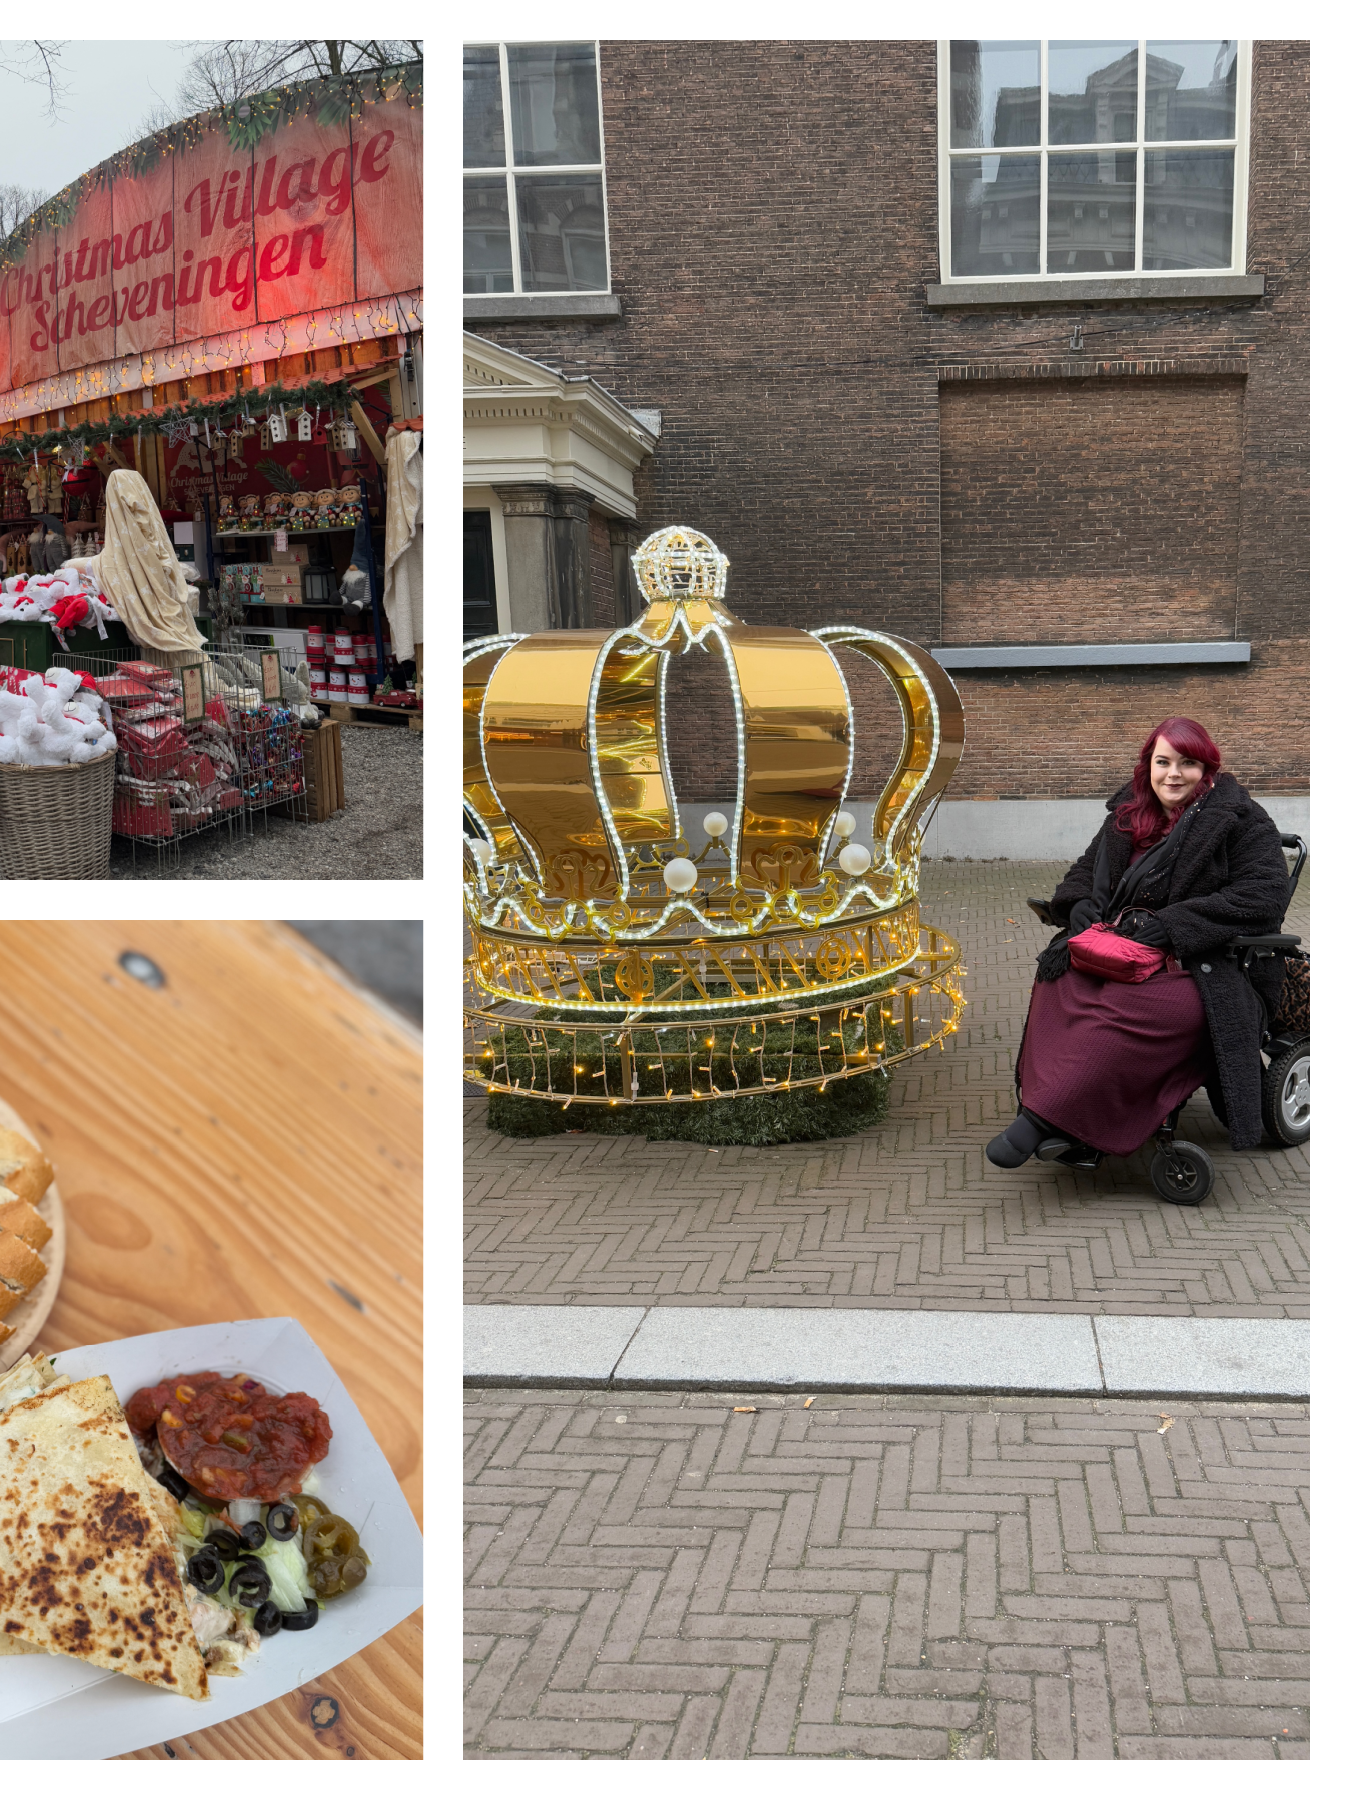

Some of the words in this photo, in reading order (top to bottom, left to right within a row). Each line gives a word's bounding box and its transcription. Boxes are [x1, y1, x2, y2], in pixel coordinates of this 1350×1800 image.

[1, 210, 174, 317] Christmas
[185, 130, 396, 237] Village
[30, 225, 328, 353] Scheveningen
